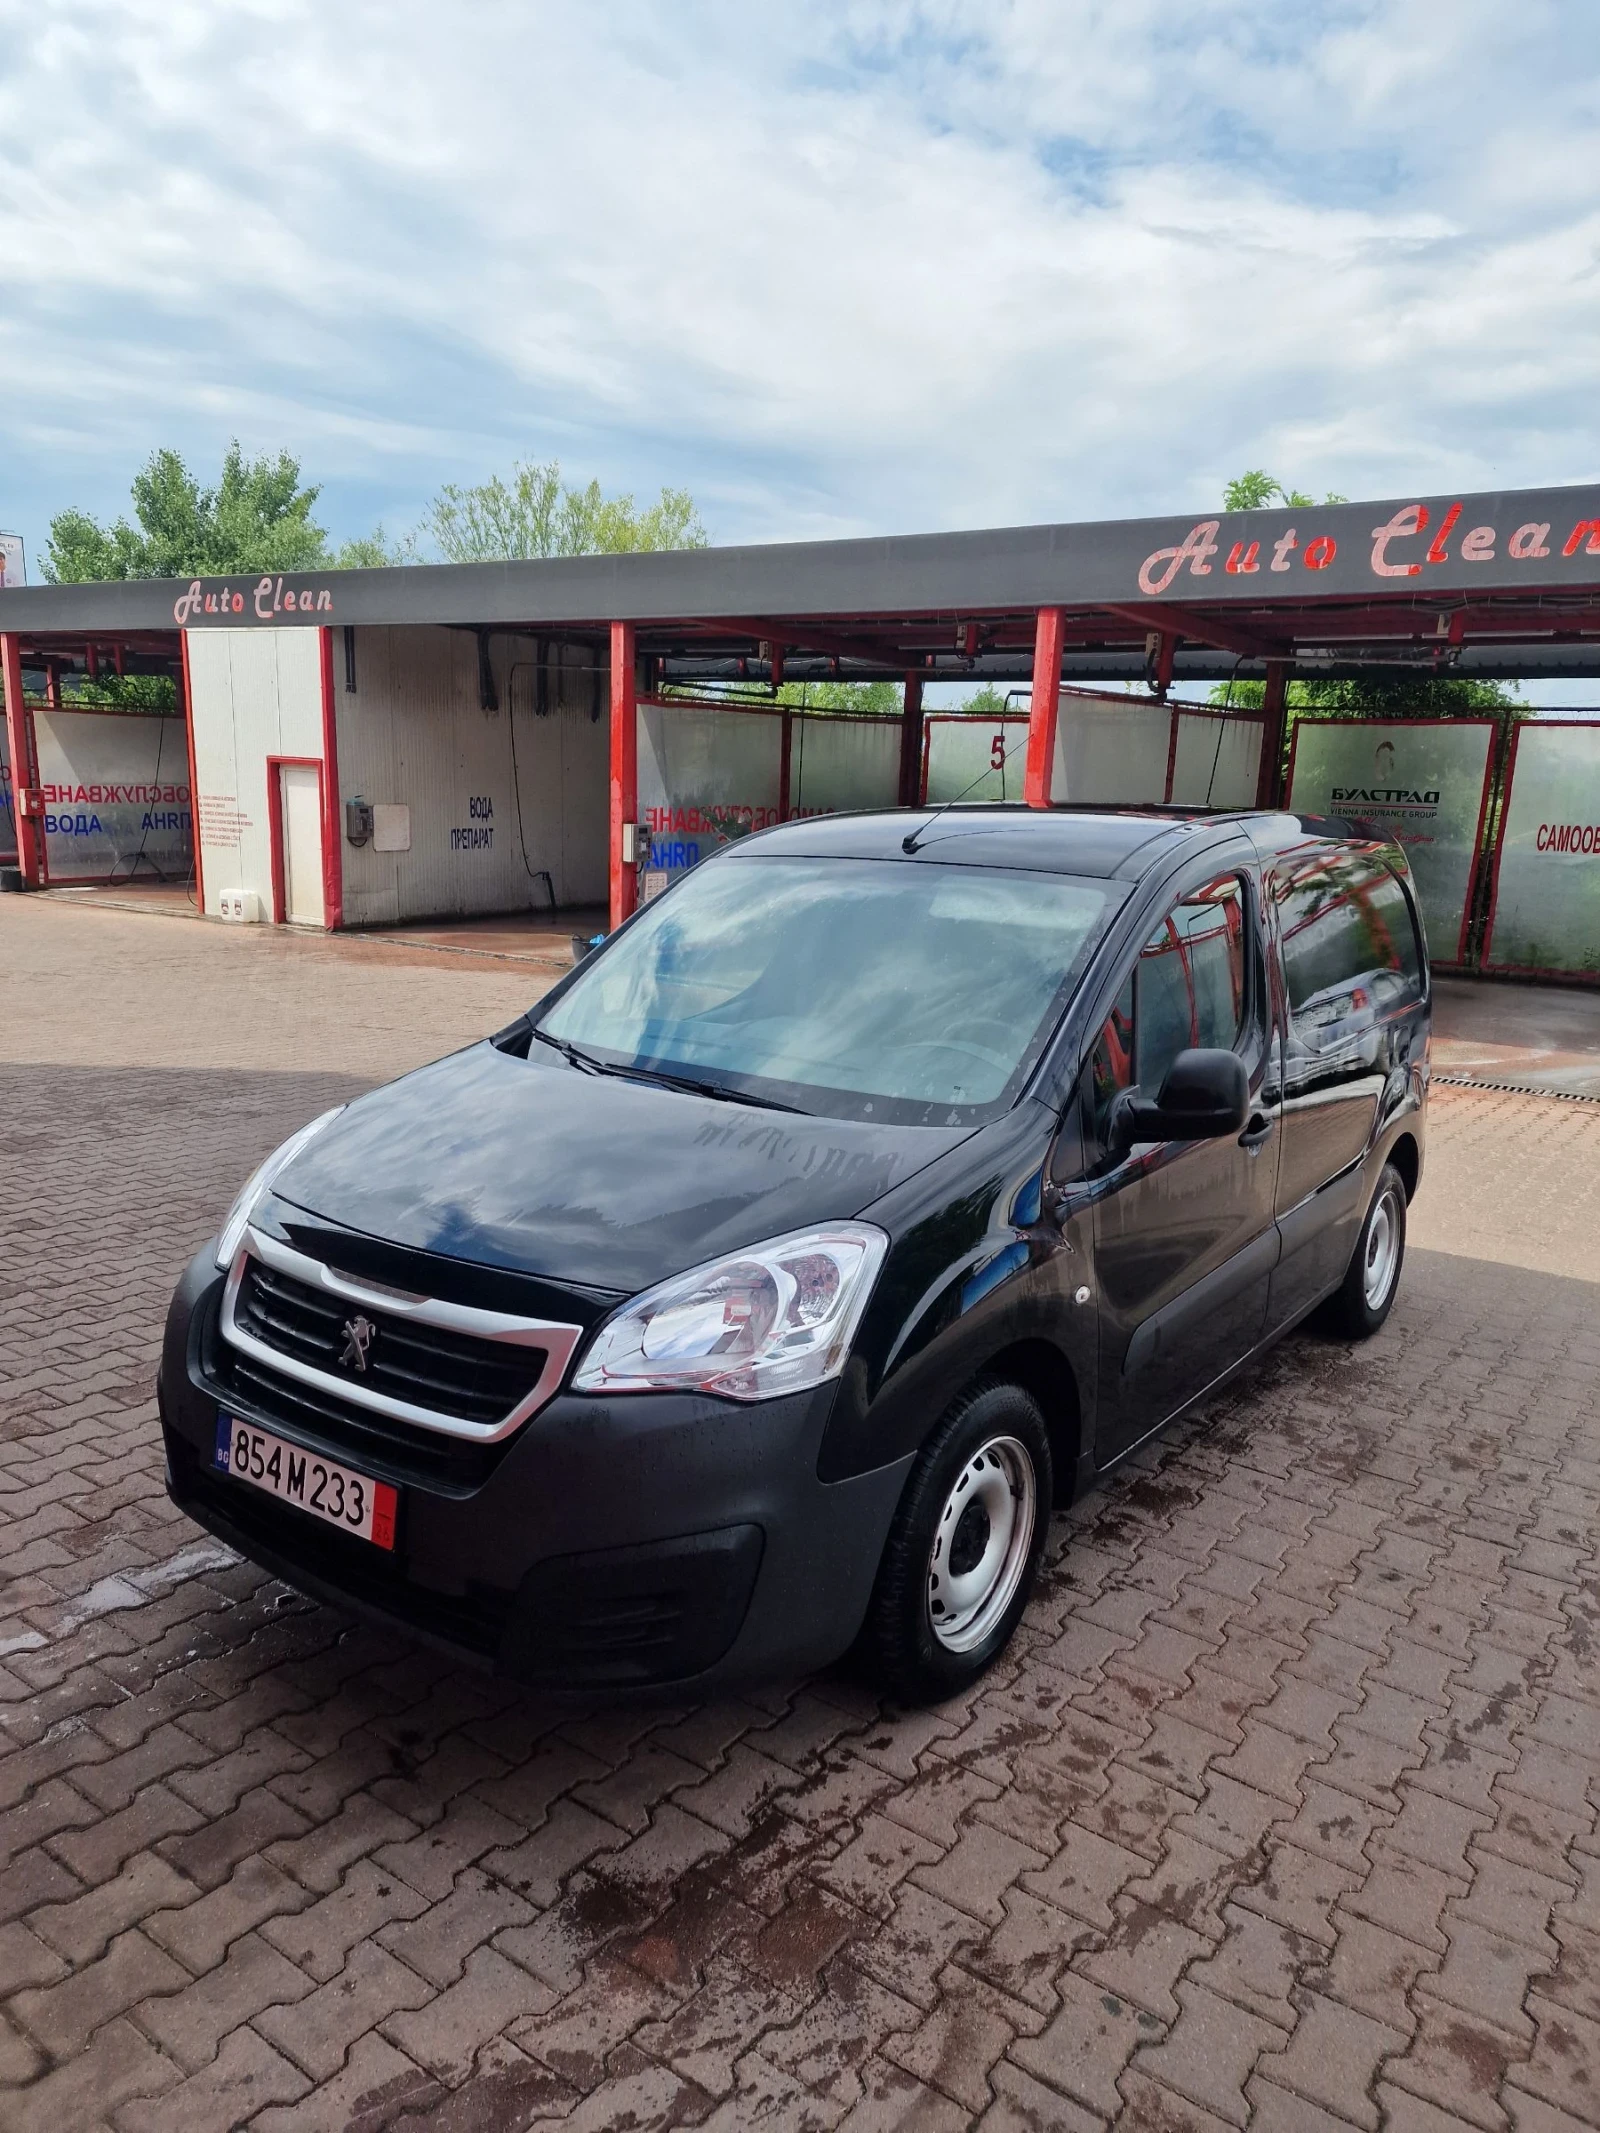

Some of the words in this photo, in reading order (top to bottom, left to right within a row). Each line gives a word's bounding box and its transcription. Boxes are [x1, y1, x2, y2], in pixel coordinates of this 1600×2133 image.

[1138, 520, 1337, 595] Auto
[1371, 501, 1600, 577] Clean
[173, 580, 244, 625] Auto
[253, 576, 333, 618] Clean
[990, 735, 1006, 770] 5
[469, 796, 494, 823] ВОДА
[1330, 808, 1359, 816] VIENNA
[1361, 809, 1406, 818] INSURANCE
[1409, 811, 1437, 819] GROUP
[45, 814, 102, 836] ВОДА
[450, 828, 494, 850] ПРЕПАРАТ
[217, 1448, 229, 1464] BG
